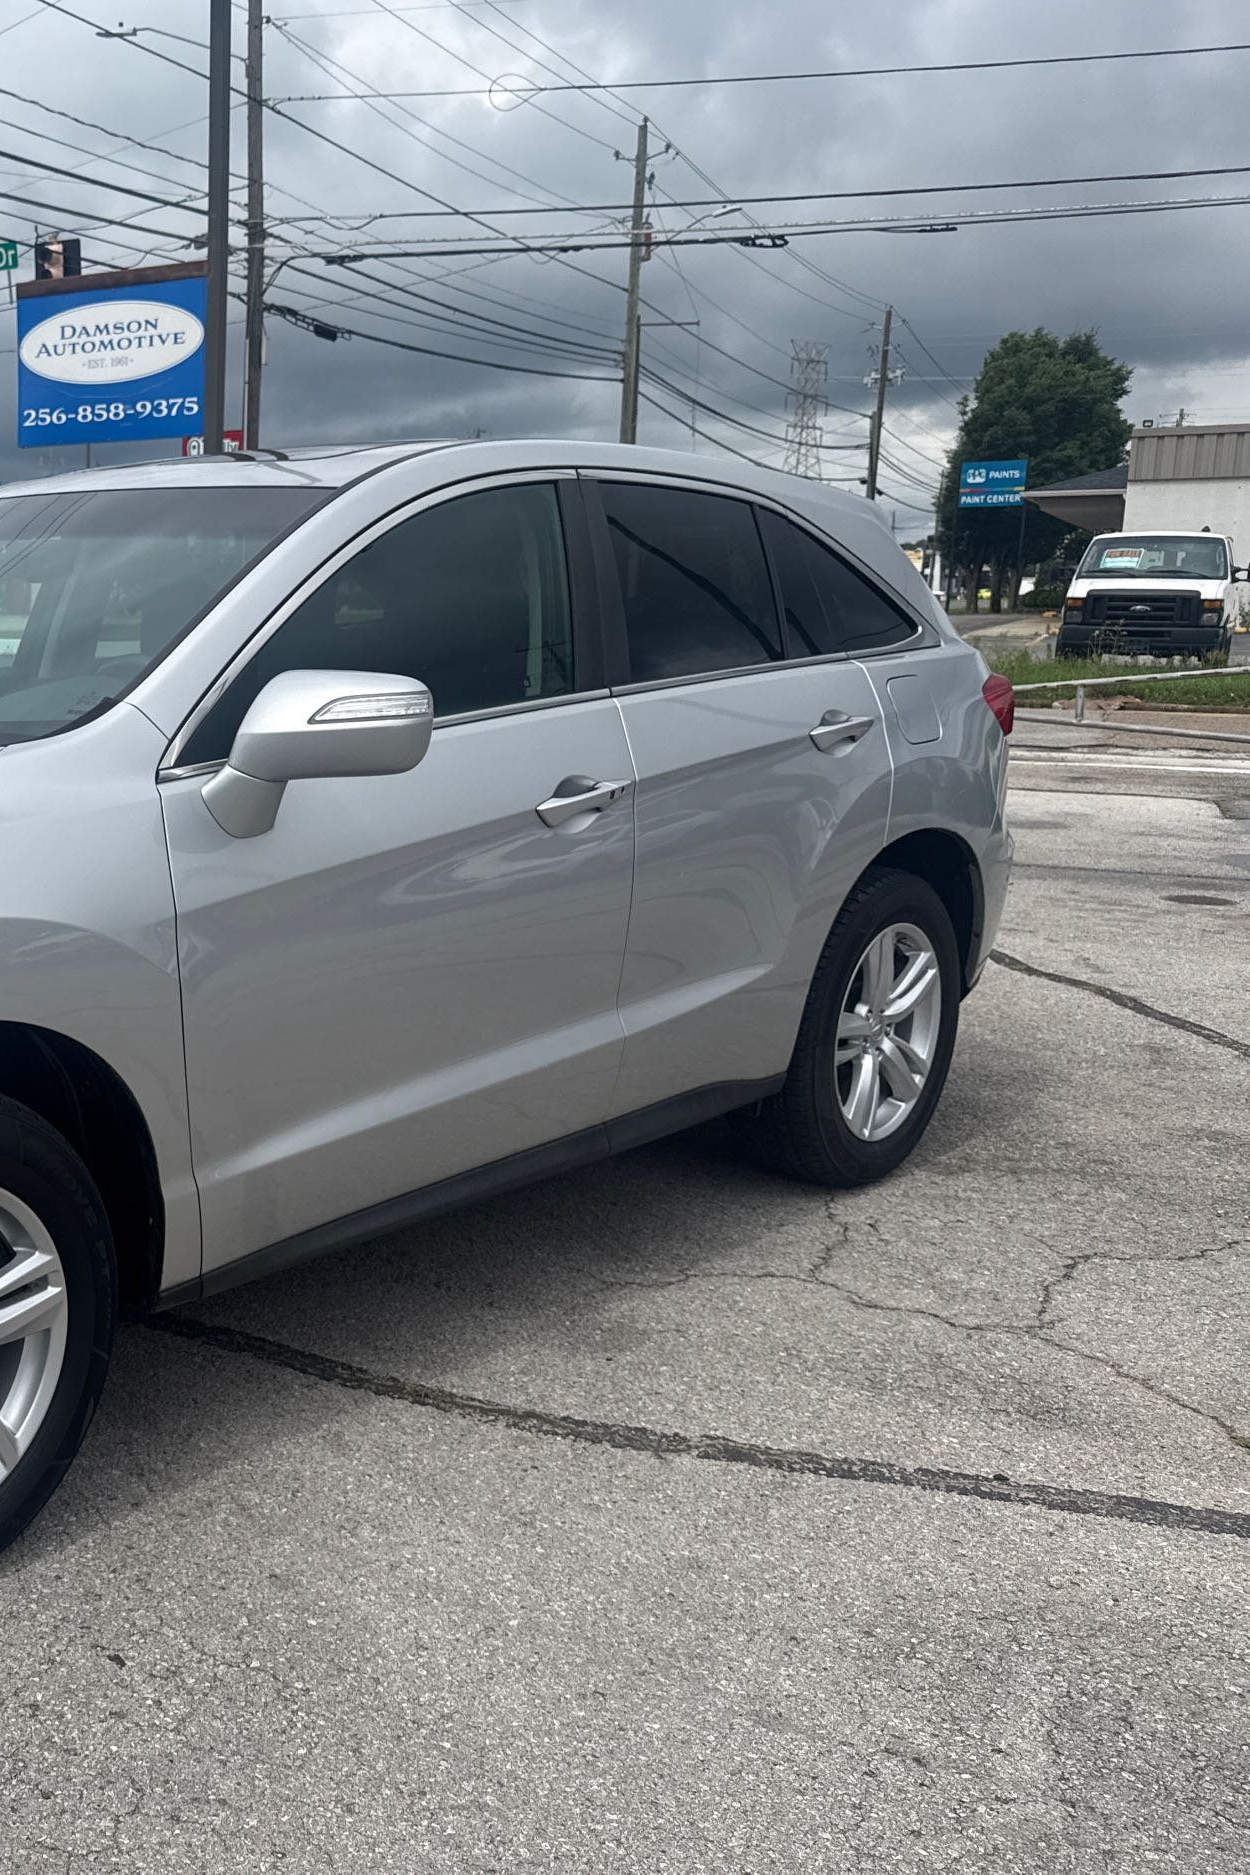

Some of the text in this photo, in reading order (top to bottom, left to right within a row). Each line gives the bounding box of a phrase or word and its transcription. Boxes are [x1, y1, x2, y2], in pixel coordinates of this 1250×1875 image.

[60, 318, 159, 340] DAMSON
[35, 331, 186, 359] AUTOMOTIVE
[22, 397, 199, 427] 256-858-9375
[989, 469, 1020, 479] PAINTS
[960, 493, 1022, 504] PAINT CENTER
